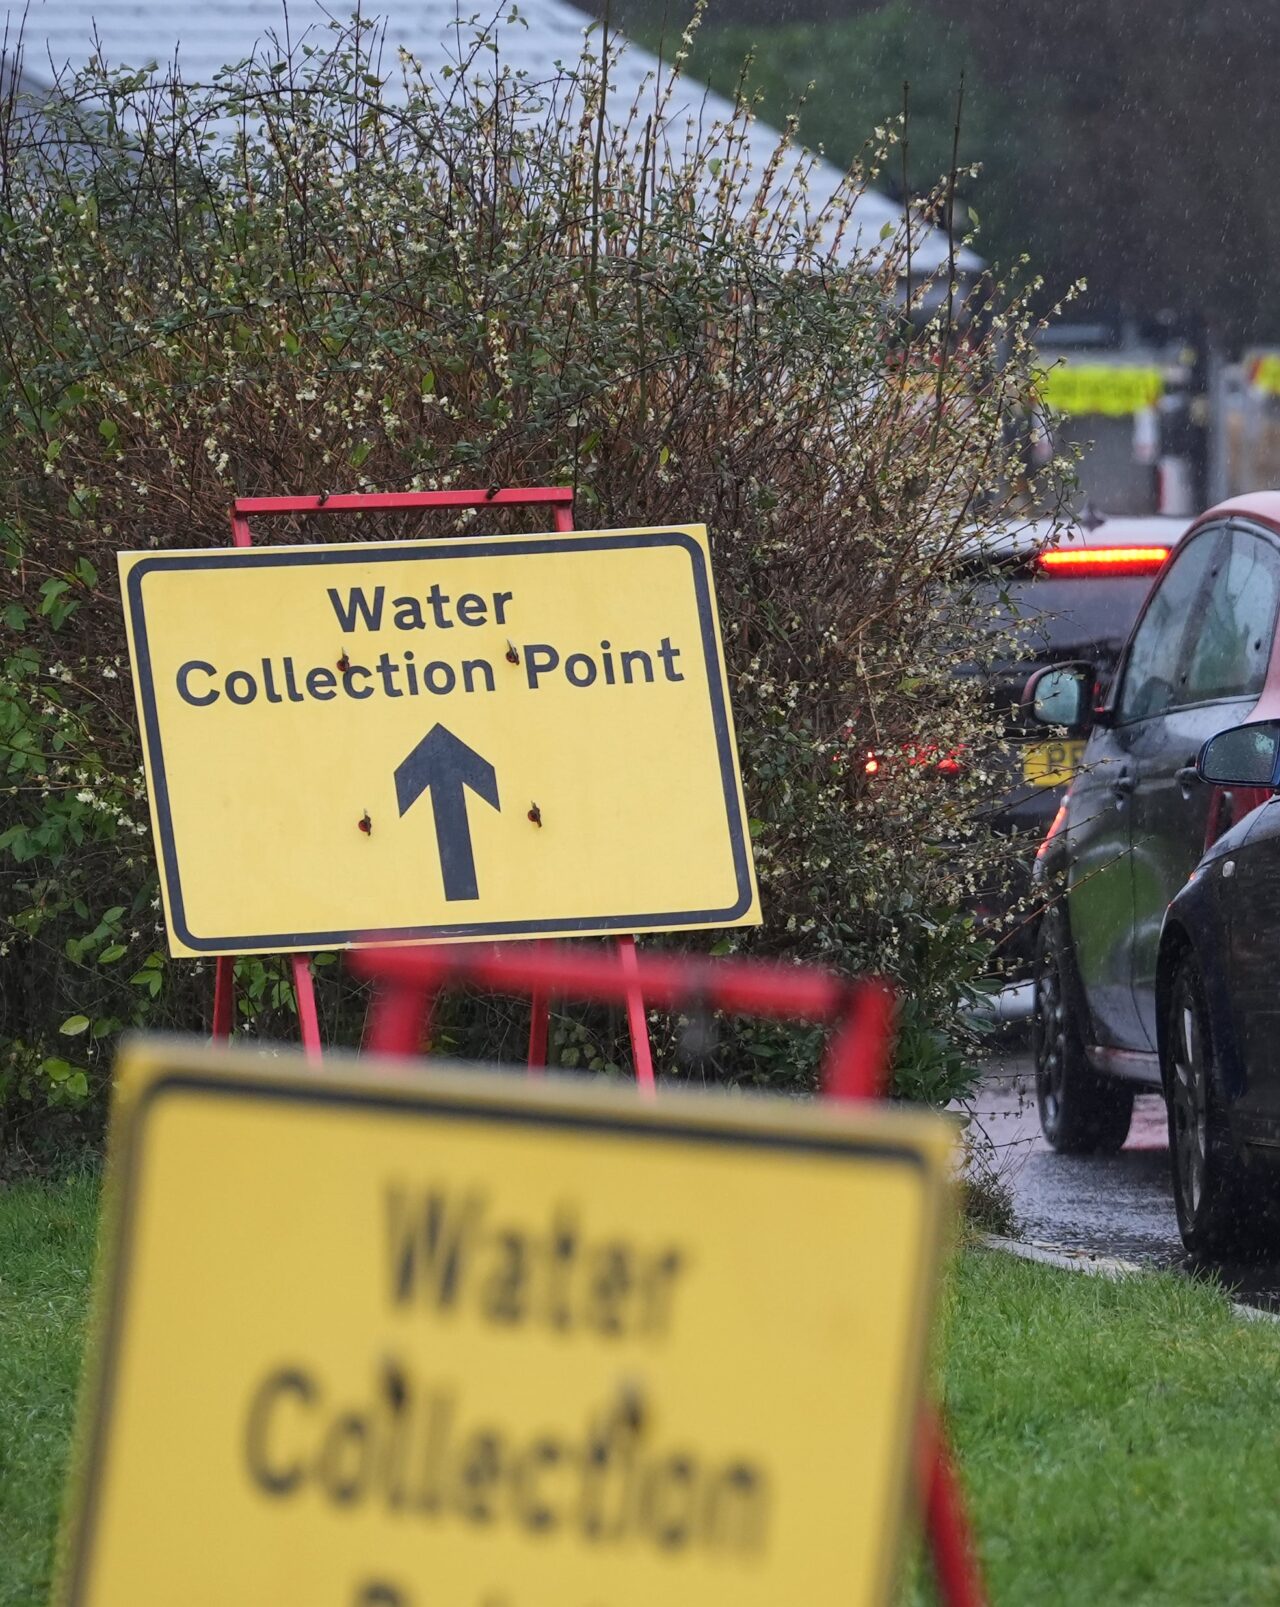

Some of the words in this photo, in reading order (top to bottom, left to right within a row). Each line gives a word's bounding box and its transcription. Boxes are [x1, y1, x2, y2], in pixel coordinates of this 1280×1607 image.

[327, 584, 513, 633] Water
[176, 650, 496, 707] Collection
[523, 636, 685, 690] Point
[384, 1184, 686, 1338] Water
[242, 1362, 772, 1562] Collection
